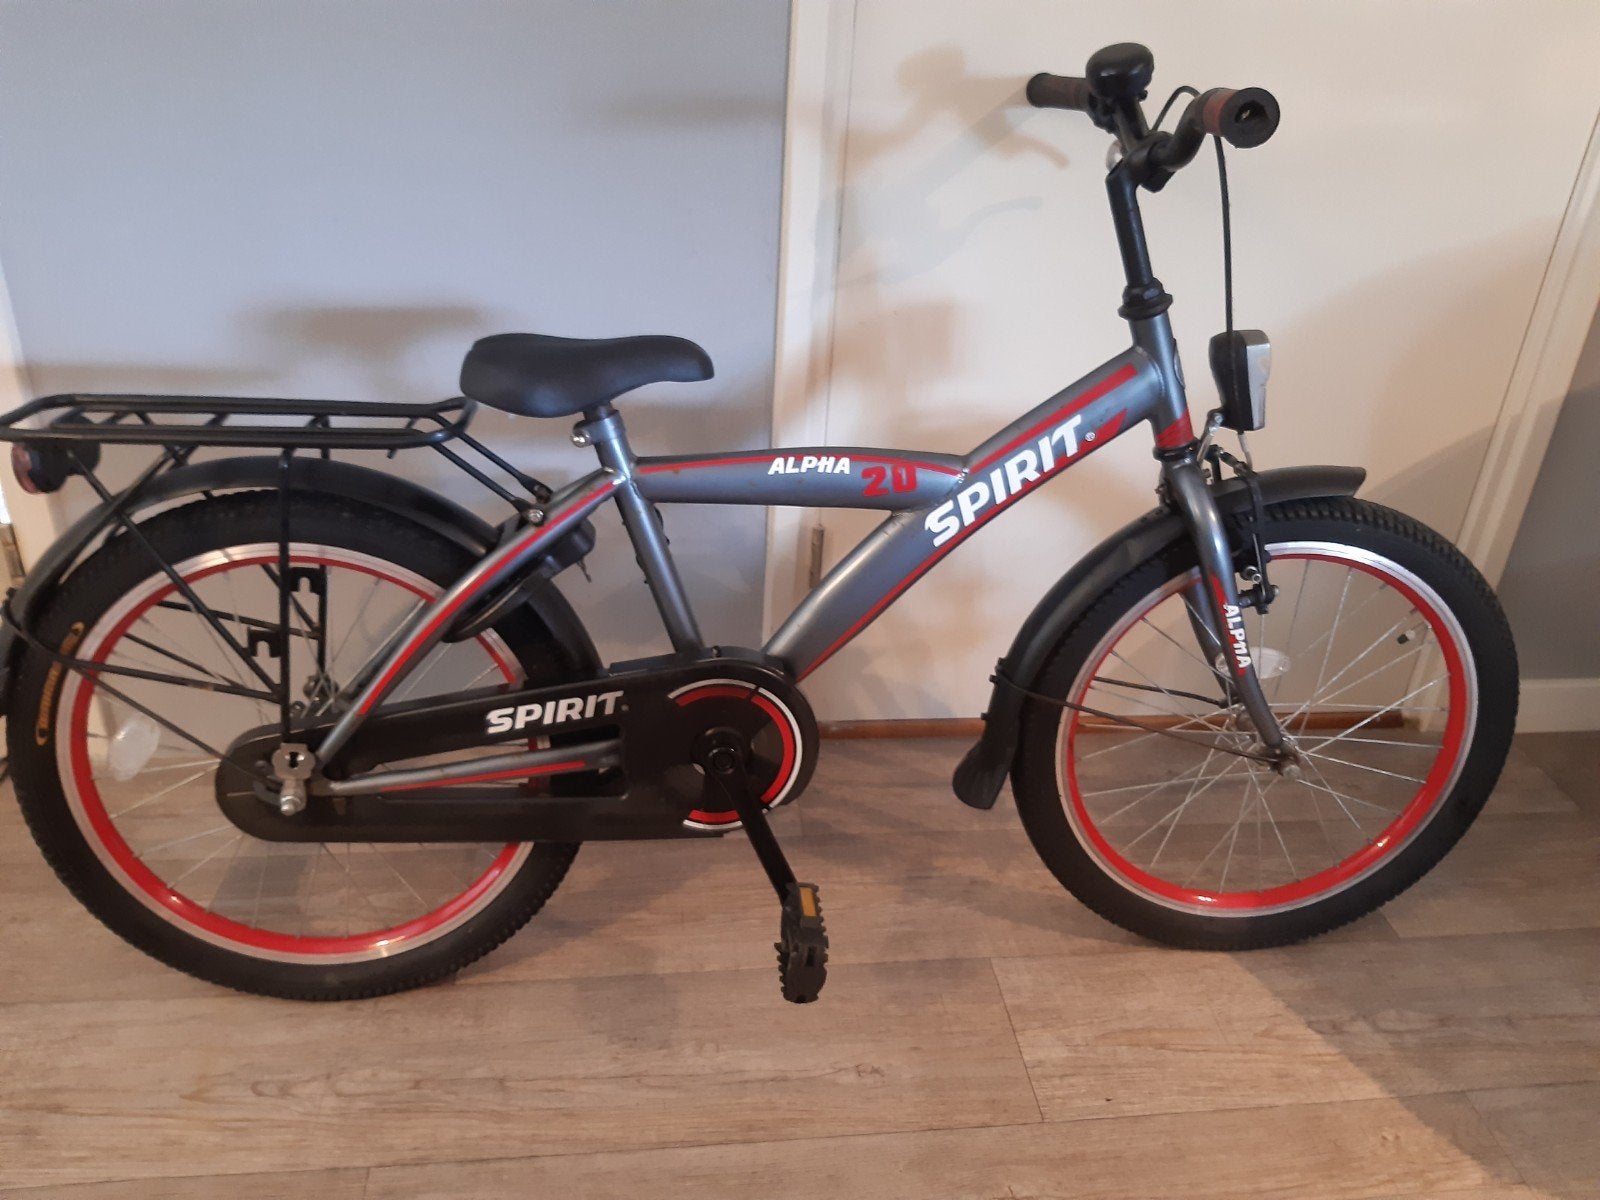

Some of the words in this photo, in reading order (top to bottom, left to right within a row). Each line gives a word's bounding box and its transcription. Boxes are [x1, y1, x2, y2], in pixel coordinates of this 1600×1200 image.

[767, 456, 850, 475] ALPHA
[861, 464, 917, 496] 20
[924, 413, 1083, 548] SPIRIT
[1223, 604, 1252, 668] ALPHA
[485, 690, 625, 734] SPIRIT
